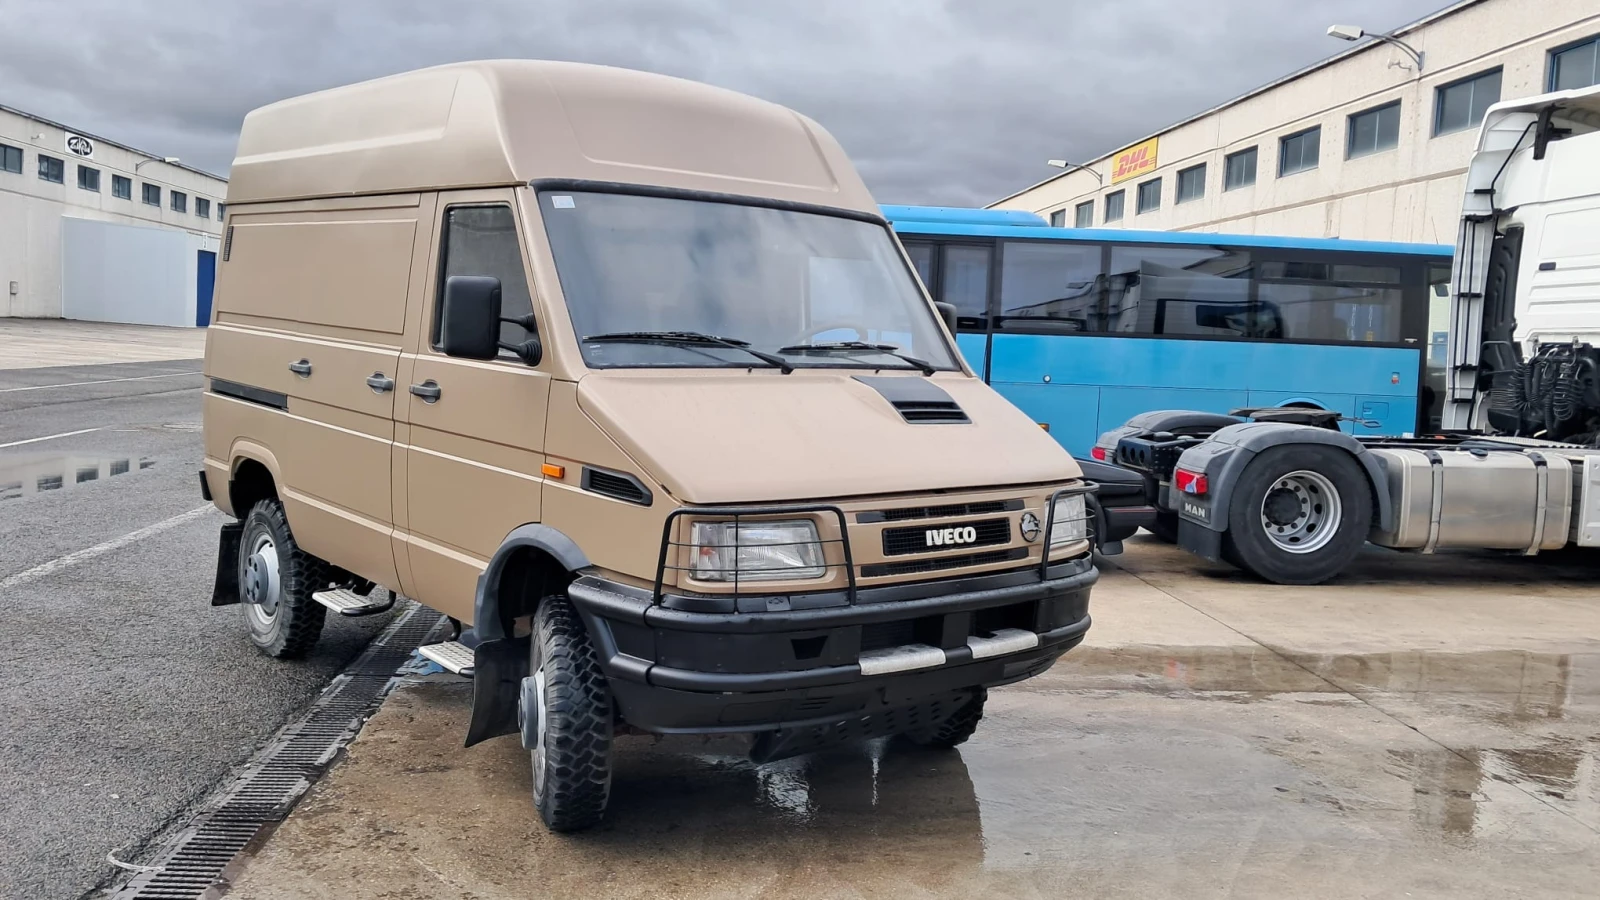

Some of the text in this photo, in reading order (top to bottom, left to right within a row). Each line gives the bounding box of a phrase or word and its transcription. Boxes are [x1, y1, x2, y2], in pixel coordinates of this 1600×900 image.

[1117, 146, 1149, 177] DHL
[1184, 502, 1206, 518] MAN
[925, 526, 977, 546] IVECO
